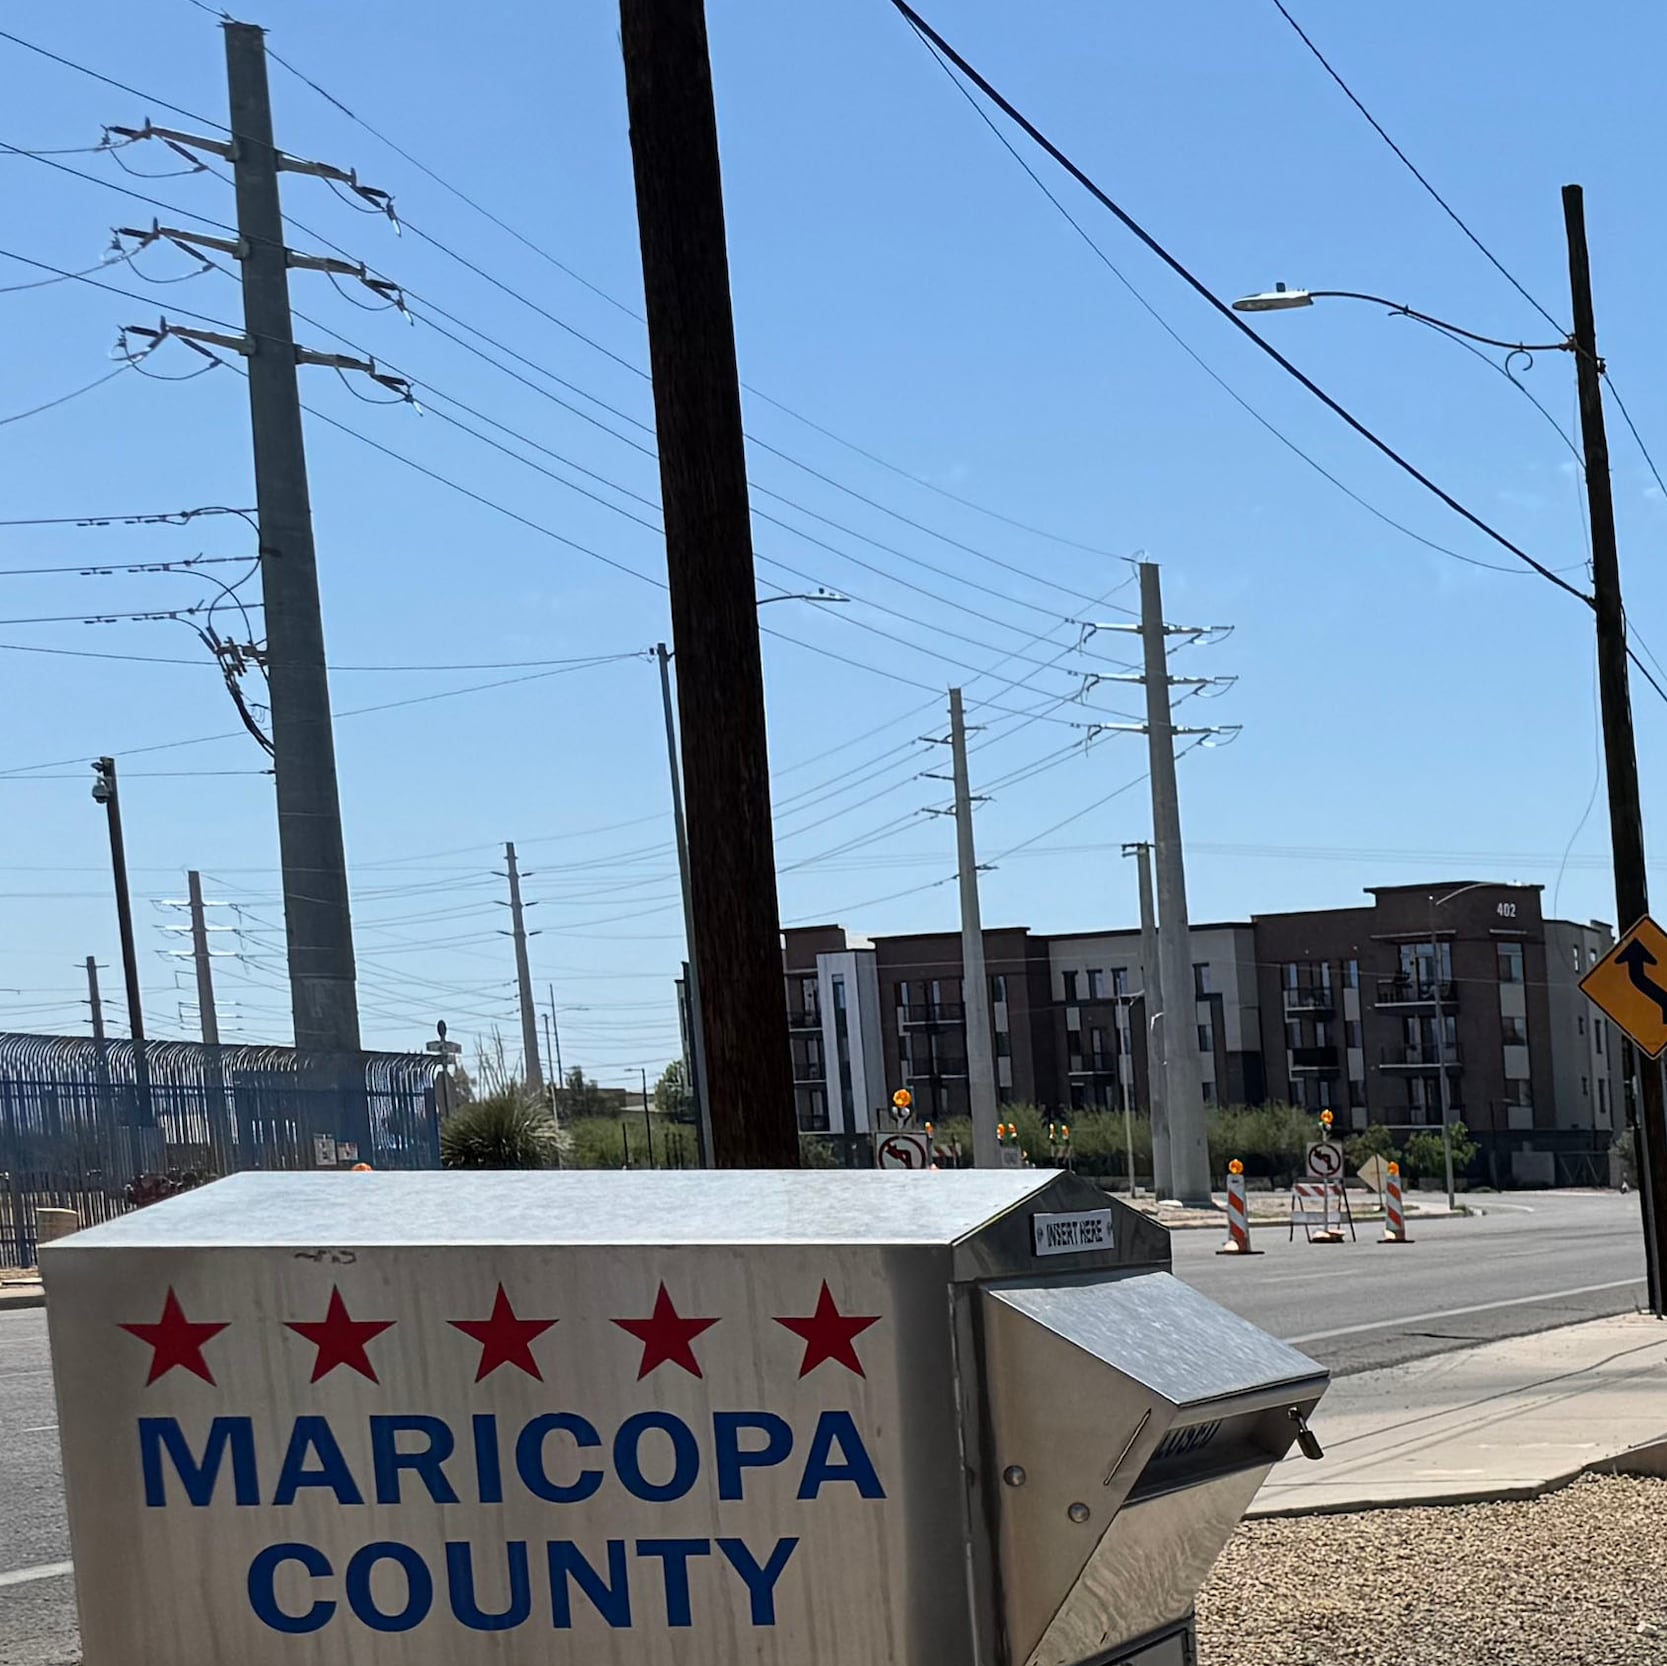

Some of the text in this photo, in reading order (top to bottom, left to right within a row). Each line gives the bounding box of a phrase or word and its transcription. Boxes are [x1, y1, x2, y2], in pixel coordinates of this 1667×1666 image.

[1496, 902, 1516, 918] 402
[1046, 1219, 1103, 1248] INSERT HERE
[139, 1411, 885, 1507] MARICOPA
[248, 1538, 797, 1635] COUNTY
